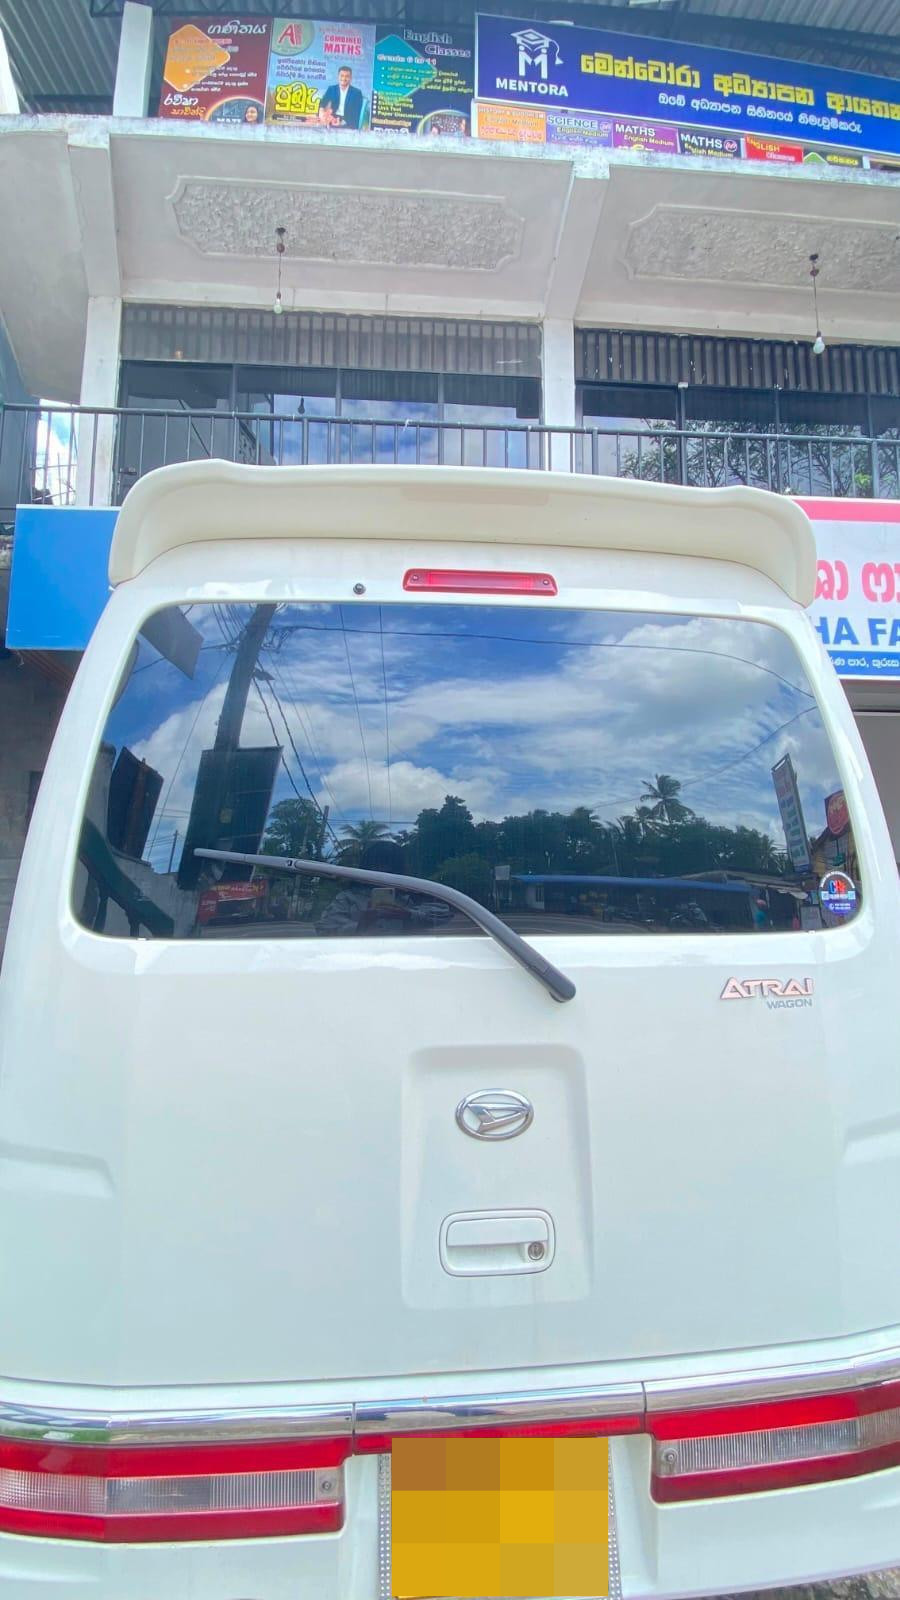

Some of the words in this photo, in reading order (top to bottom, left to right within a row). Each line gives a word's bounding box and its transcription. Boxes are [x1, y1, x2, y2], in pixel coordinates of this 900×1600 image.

[324, 34, 361, 45] COMBINED
[404, 29, 452, 44] English
[324, 43, 361, 56] MATHS
[425, 43, 471, 58] Classes
[496, 77, 568, 97] MENTORA
[547, 114, 598, 128] SCIENCE
[615, 123, 656, 137] MATHS
[624, 134, 648, 143] English
[649, 138, 674, 146] Medium
[680, 133, 723, 149] MATHS
[719, 977, 815, 1001] ATRAI
[766, 998, 813, 1010] WAGON
